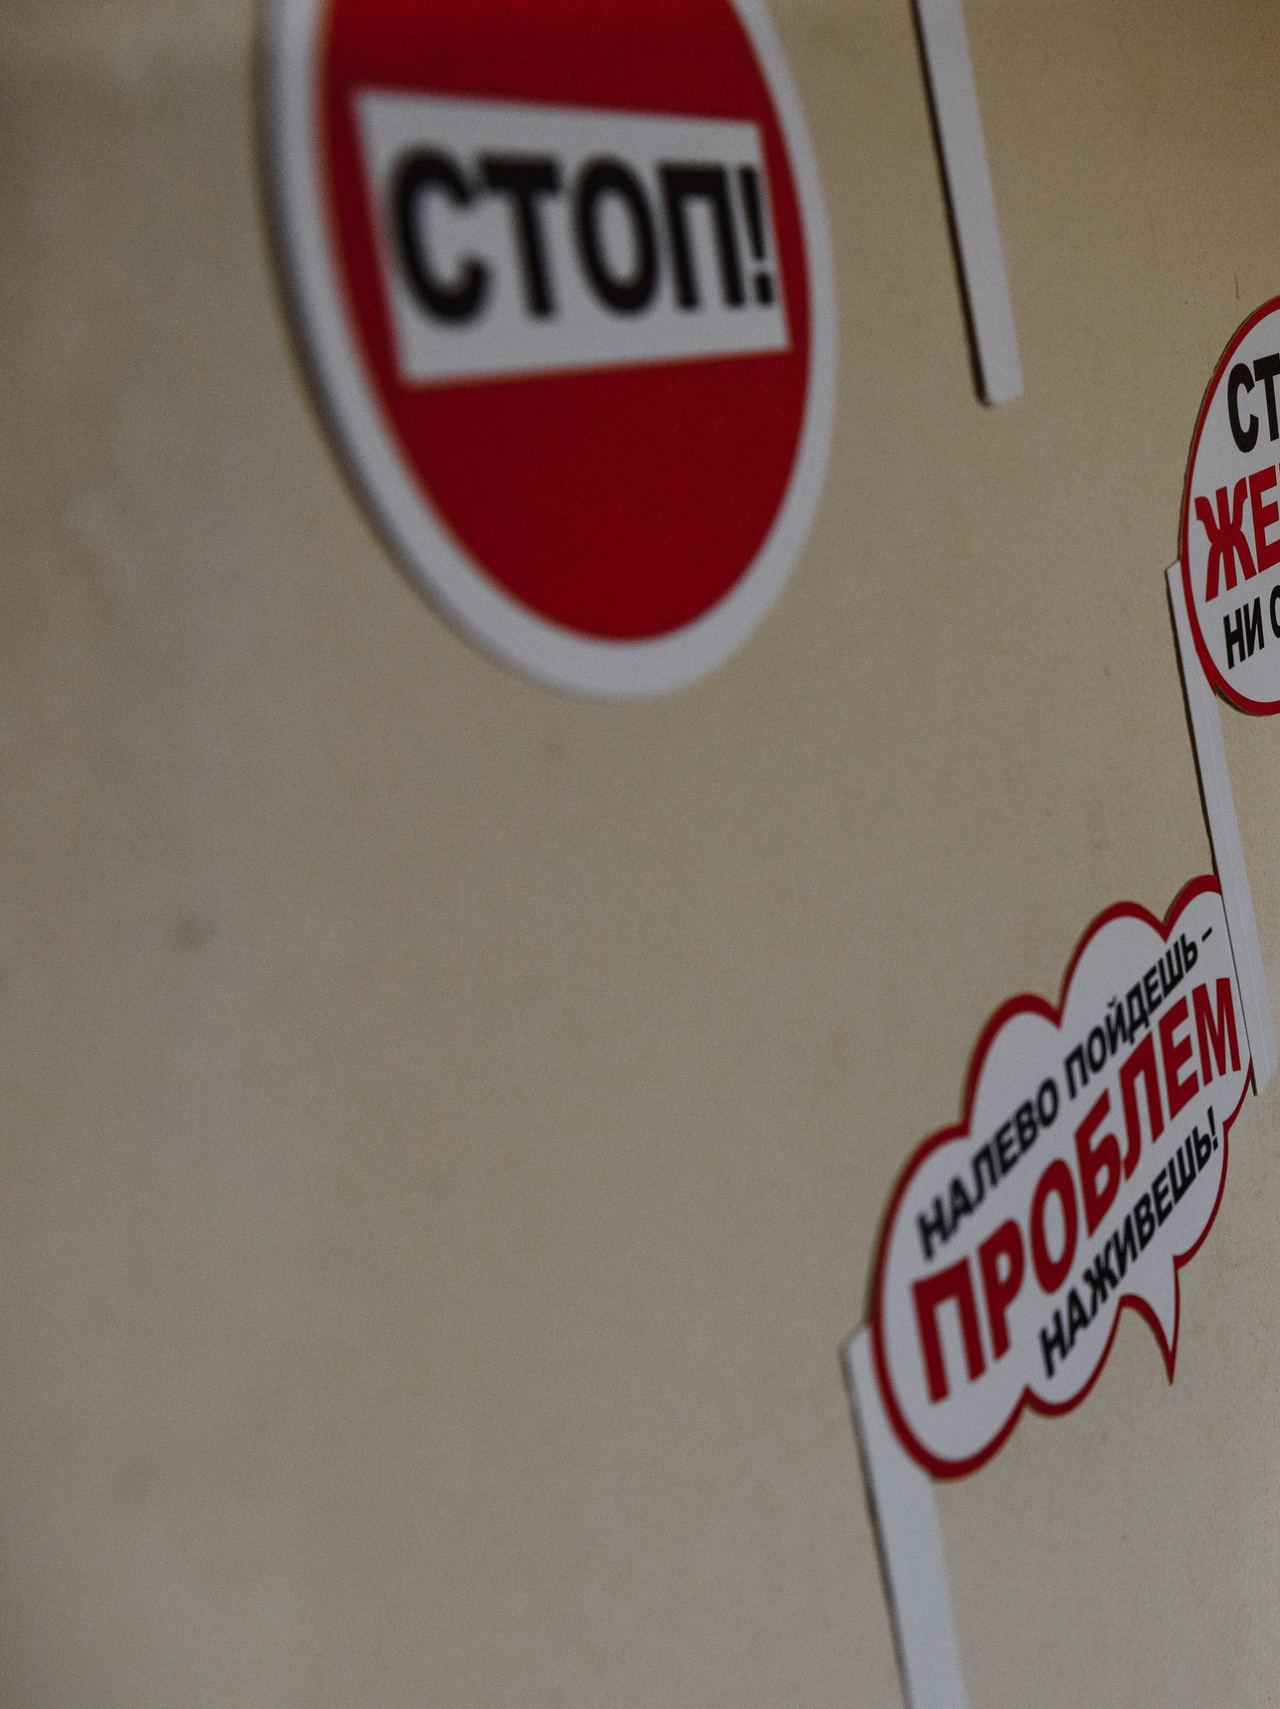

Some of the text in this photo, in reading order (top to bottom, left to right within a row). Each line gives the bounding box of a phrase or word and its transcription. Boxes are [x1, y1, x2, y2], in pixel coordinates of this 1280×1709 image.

[392, 145, 774, 324] СТОП!
[1223, 603, 1265, 669] НИ
[912, 977, 1241, 1403] ПРОБЛЕМ
[915, 1078, 1060, 1261] НАЛЕВО
[1063, 932, 1199, 1101] ПОЙДЕШЬ
[1039, 1105, 1219, 1378] НАЖИВЕШЬ!
